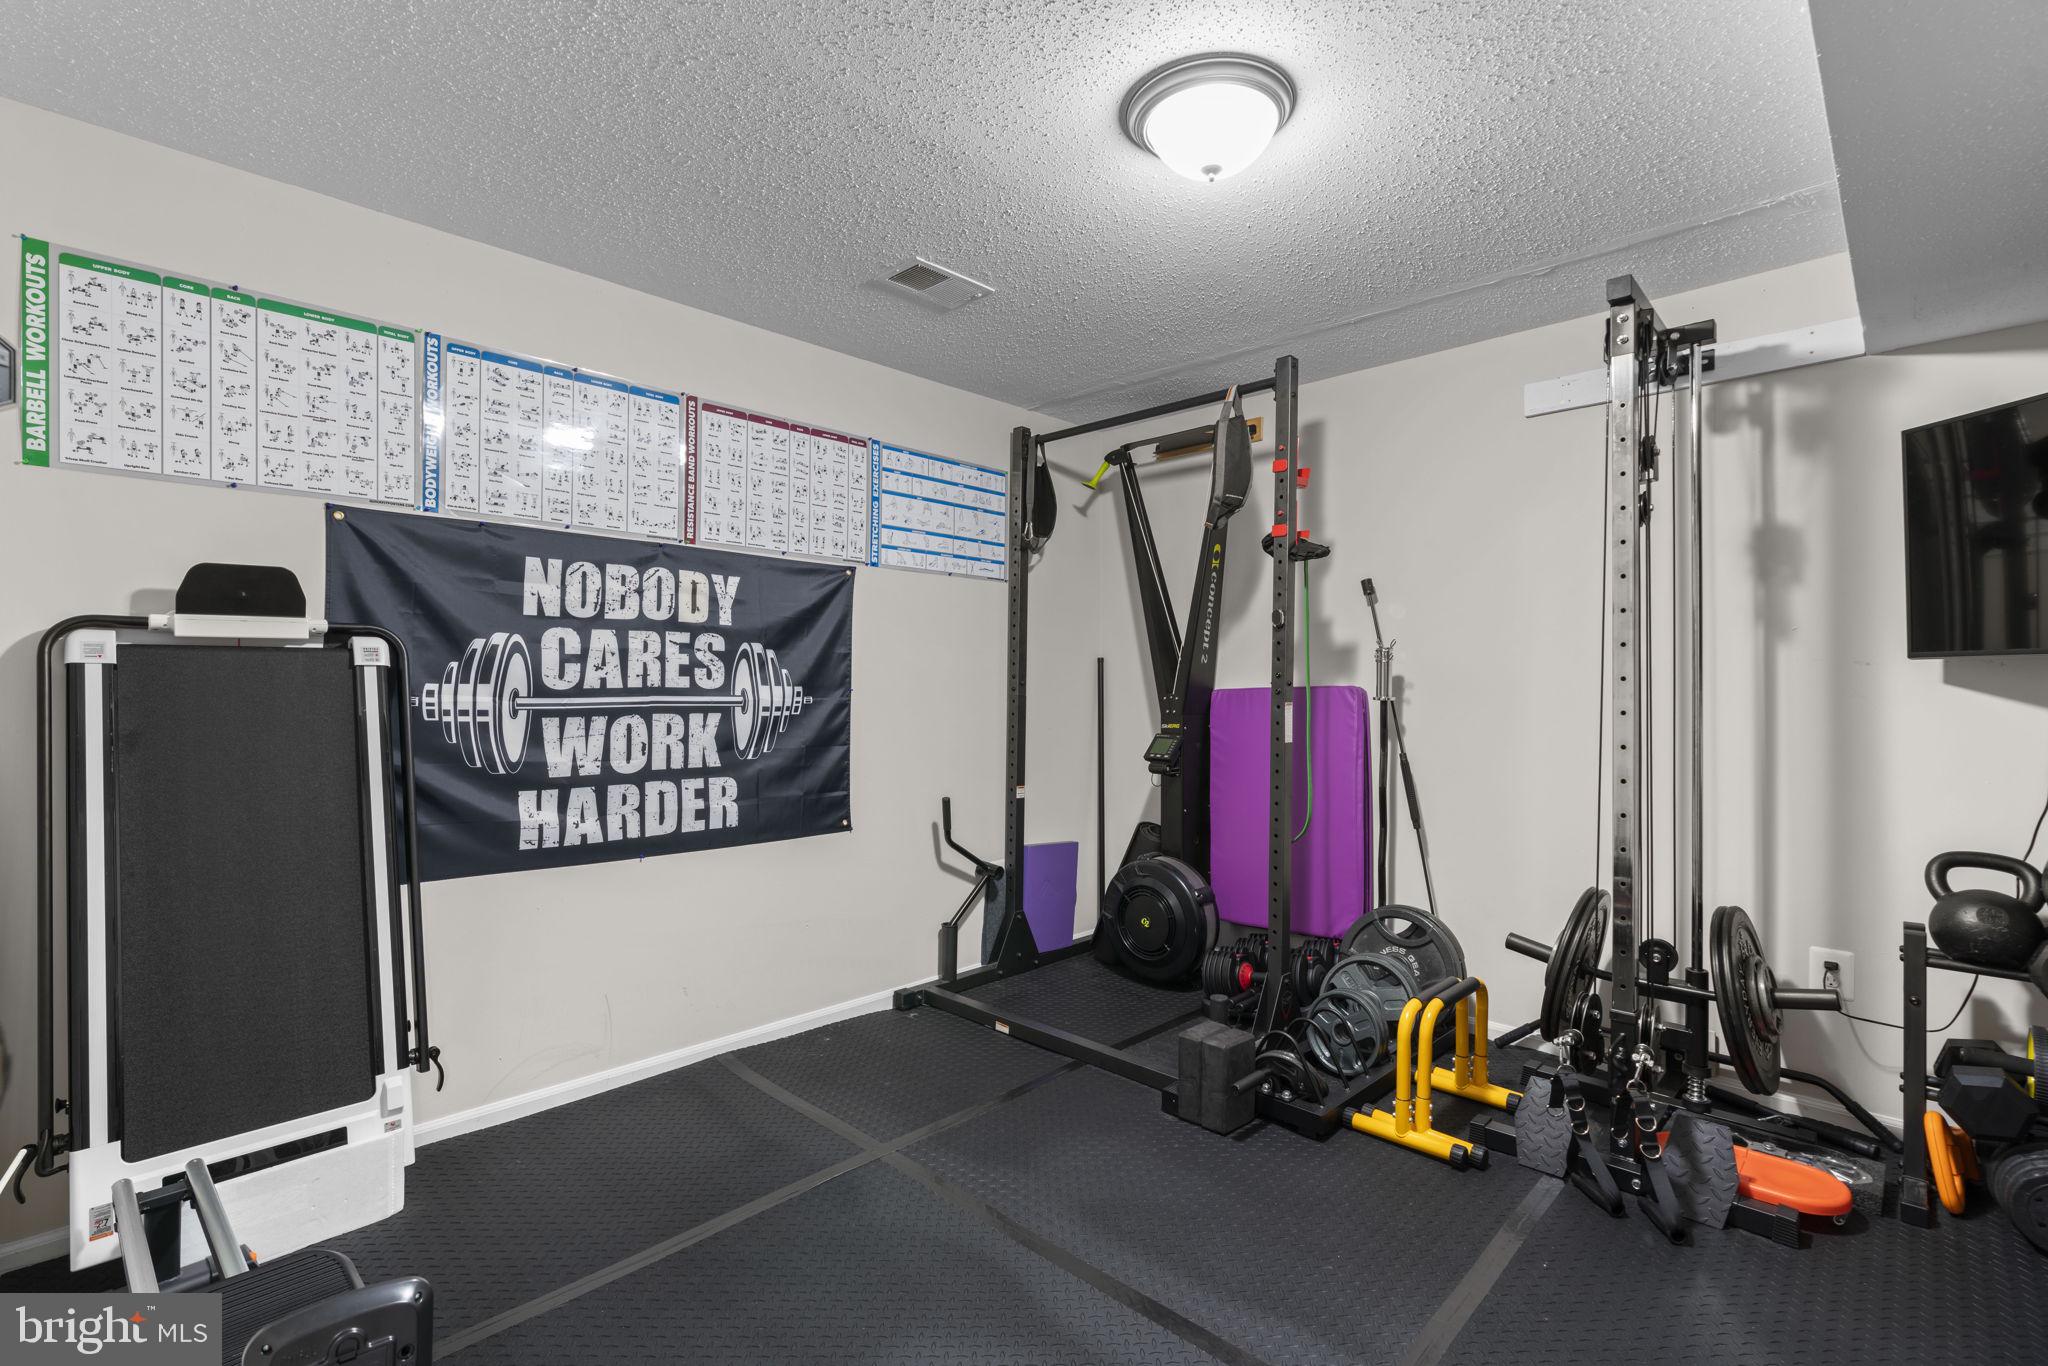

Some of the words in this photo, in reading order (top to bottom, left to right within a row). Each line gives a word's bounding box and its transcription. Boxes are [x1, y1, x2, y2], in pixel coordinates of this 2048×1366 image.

[92, 263, 112, 273] UPPER
[114, 267, 130, 276] BODY
[26, 253, 46, 361] WORKOUTS
[26, 370, 46, 452] BARBELL
[688, 400, 696, 455] WORKOUTS
[425, 420, 440, 509] BODYWEIGH
[687, 456, 696, 482] BAND
[686, 484, 695, 540] RESISTANCE
[871, 501, 879, 563] STRETCHING
[523, 556, 741, 626] NOBODY
[1202, 571, 1217, 650] concept
[540, 626, 726, 690] CARES
[541, 713, 722, 778] WORK
[518, 776, 739, 851] HARDER
